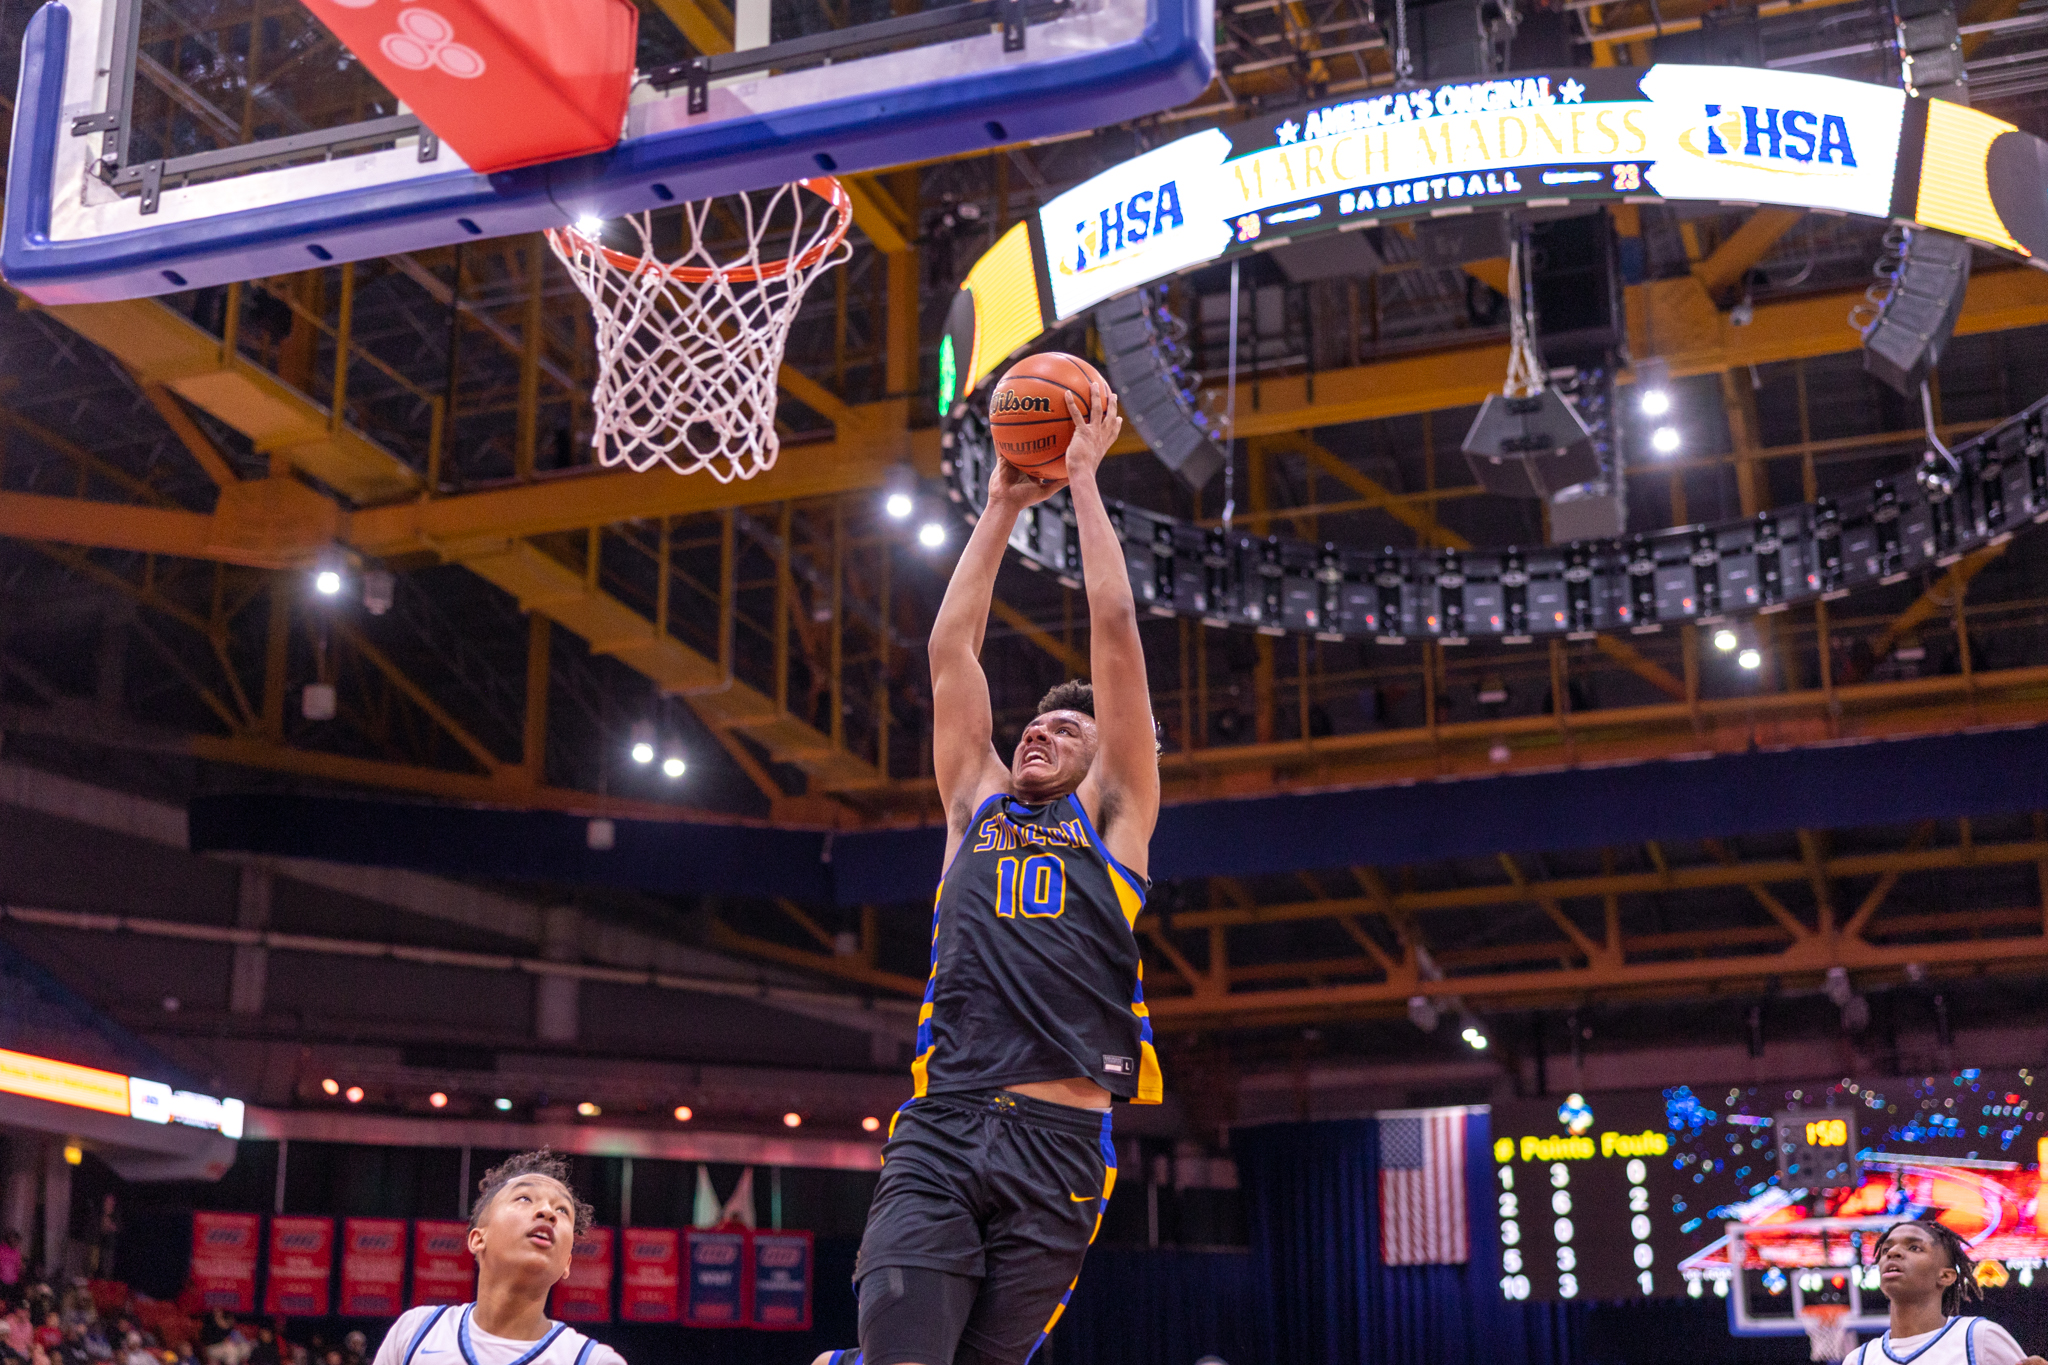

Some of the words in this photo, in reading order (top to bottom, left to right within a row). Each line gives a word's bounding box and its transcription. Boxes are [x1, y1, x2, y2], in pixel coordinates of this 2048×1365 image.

[1303, 88, 1433, 140] AMERICA'S
[1434, 75, 1556, 116] ORIGINAL
[1235, 131, 1390, 202] MARCH
[1417, 109, 1647, 166] MADNESS
[1339, 171, 1522, 215] BASKETBALL
[1612, 163, 1641, 190] 23
[996, 434, 1057, 452] VOLUTION
[995, 852, 1067, 919] 10
[1497, 1165, 1514, 1190] 1
[1550, 1162, 1570, 1188] 3
[1626, 1158, 1647, 1184] 0
[1498, 1192, 1519, 1218] 2
[1629, 1186, 1650, 1212] 2
[1500, 1219, 1521, 1245] 3
[1554, 1217, 1574, 1243] 0
[1631, 1214, 1651, 1240] 0
[1502, 1248, 1523, 1274] 5
[1556, 1246, 1577, 1272] 3
[1633, 1243, 1654, 1269] 0
[1499, 1274, 1531, 1300] 10
[1558, 1273, 1579, 1299] 3
[1637, 1270, 1654, 1296] 1
